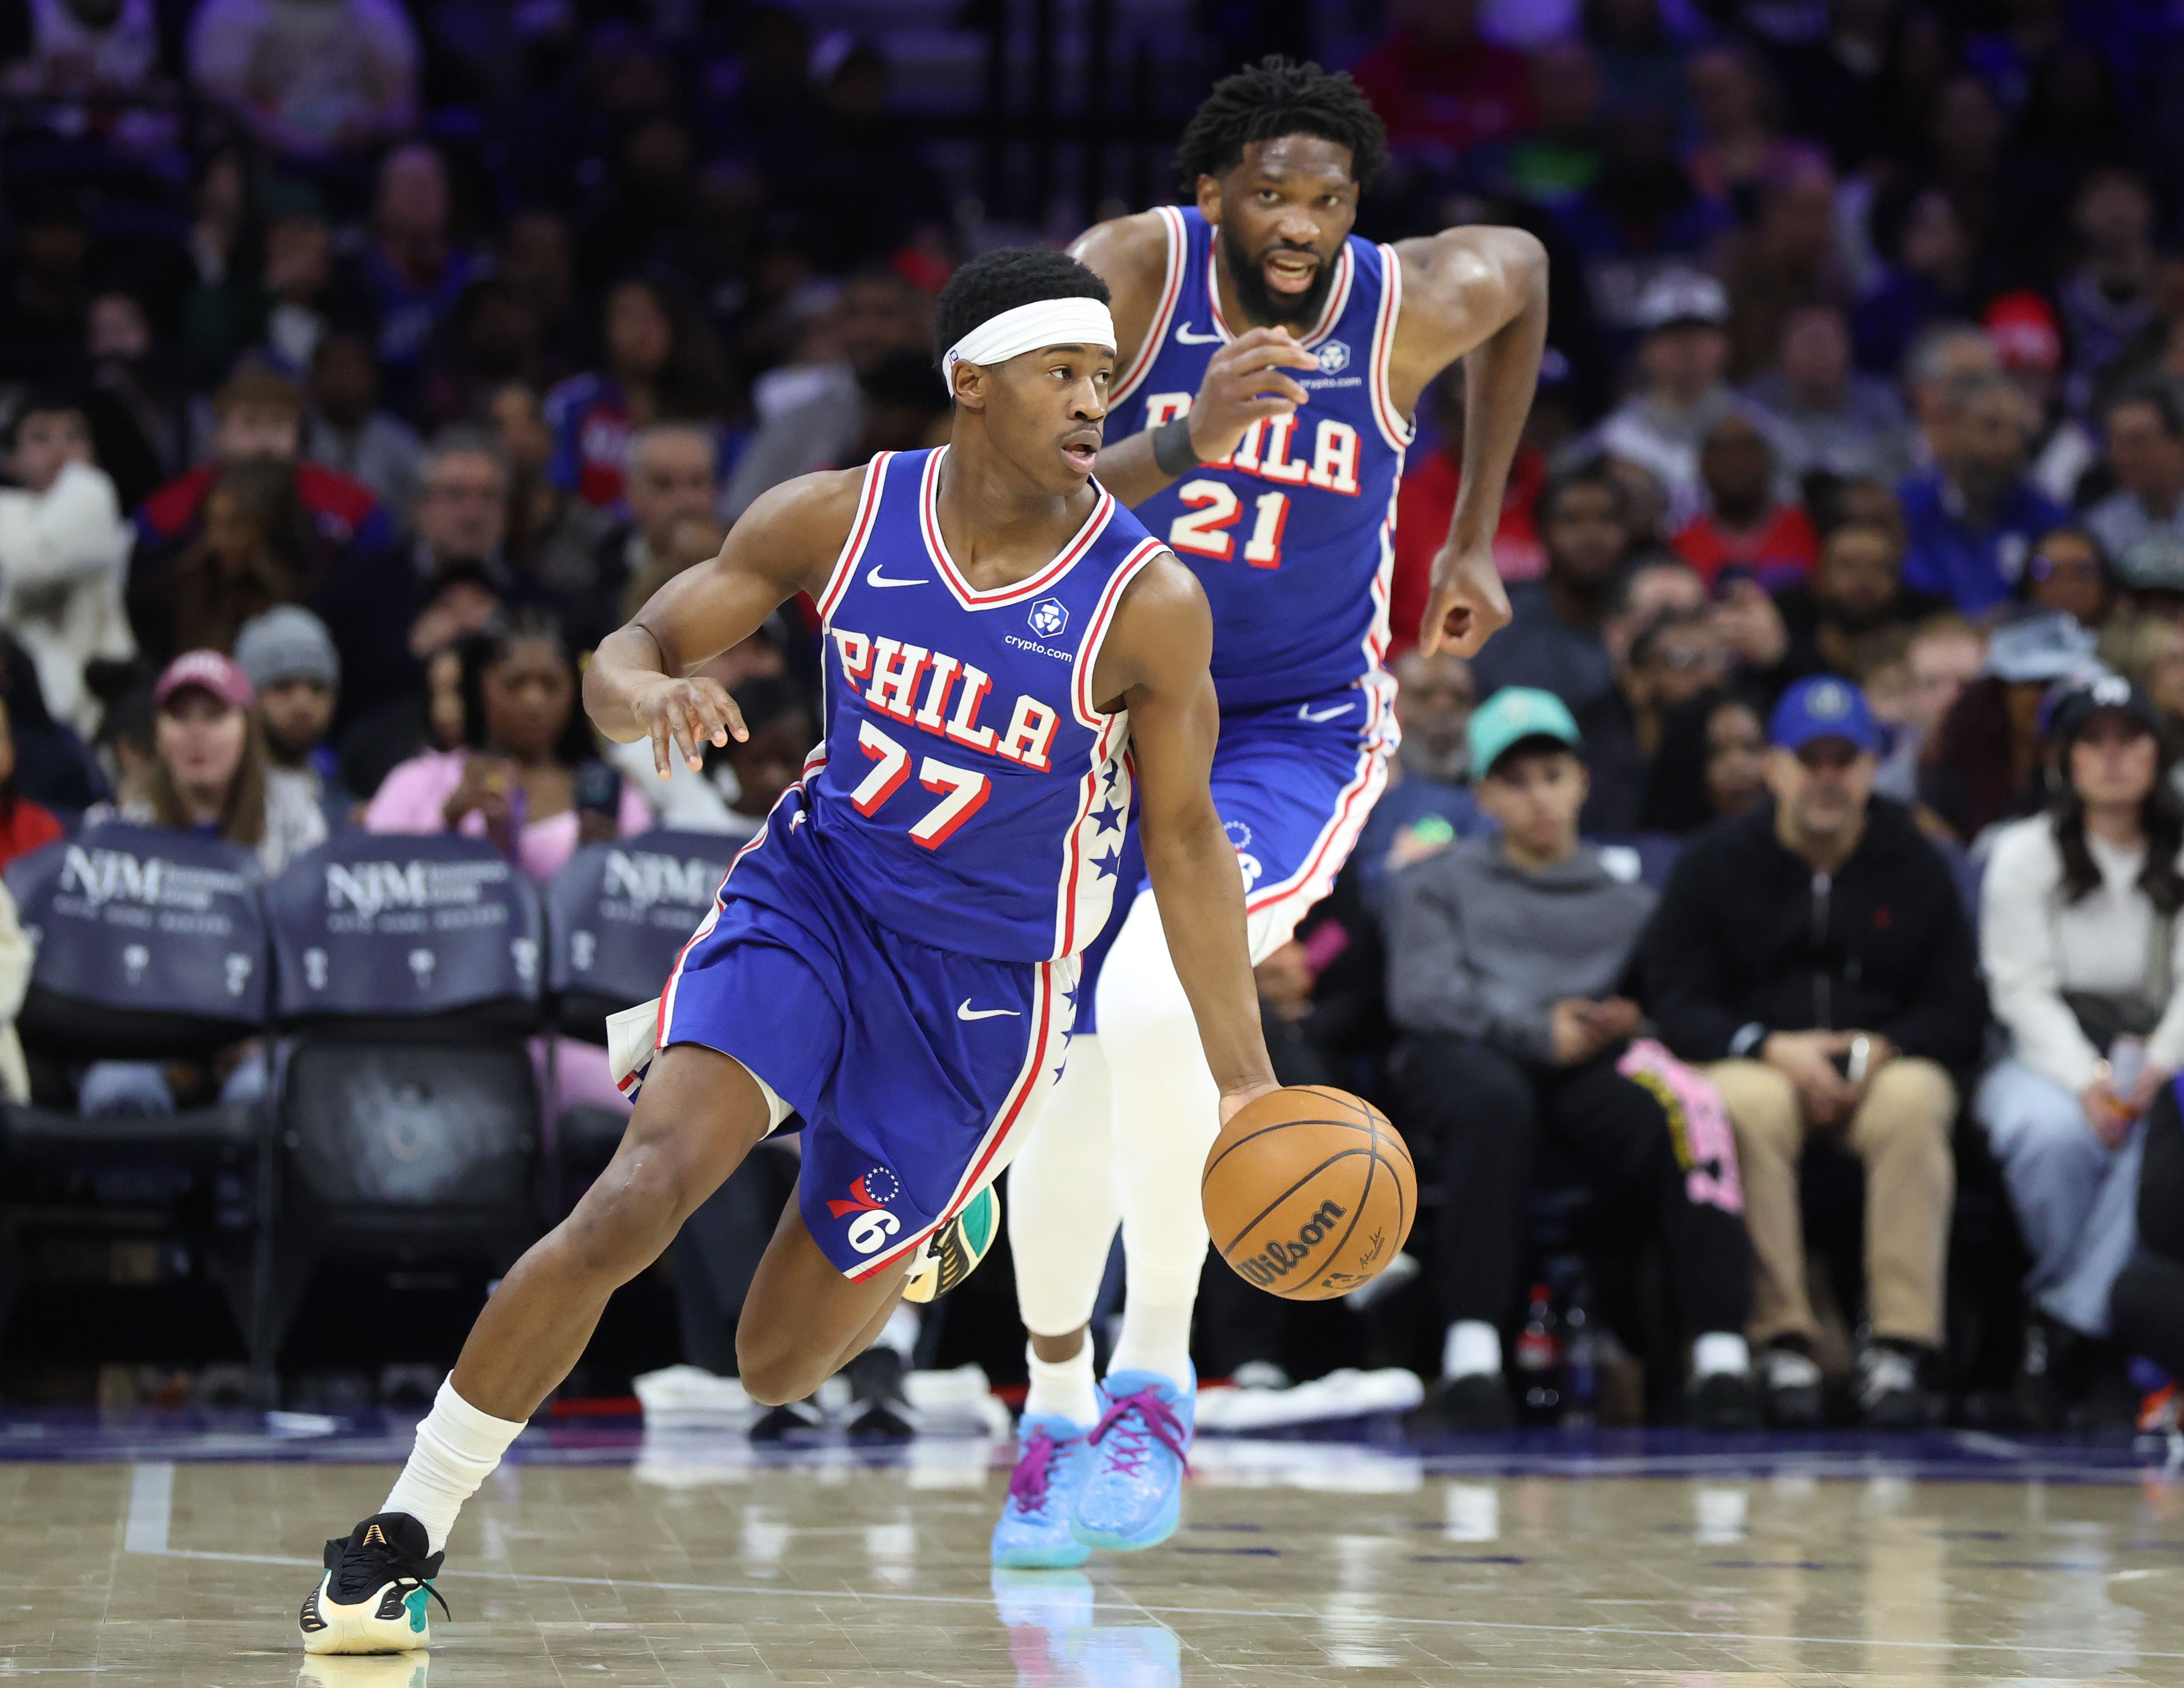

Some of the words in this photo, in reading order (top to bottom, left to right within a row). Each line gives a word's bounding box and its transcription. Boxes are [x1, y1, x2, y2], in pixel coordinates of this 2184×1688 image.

[1145, 391, 1362, 497] PILA
[1169, 479, 1291, 570] 21
[1005, 635, 1073, 663] crypto.com
[831, 627, 1061, 773] PHILA
[849, 719, 992, 851] 77
[1235, 1199, 1348, 1287] Wilson
